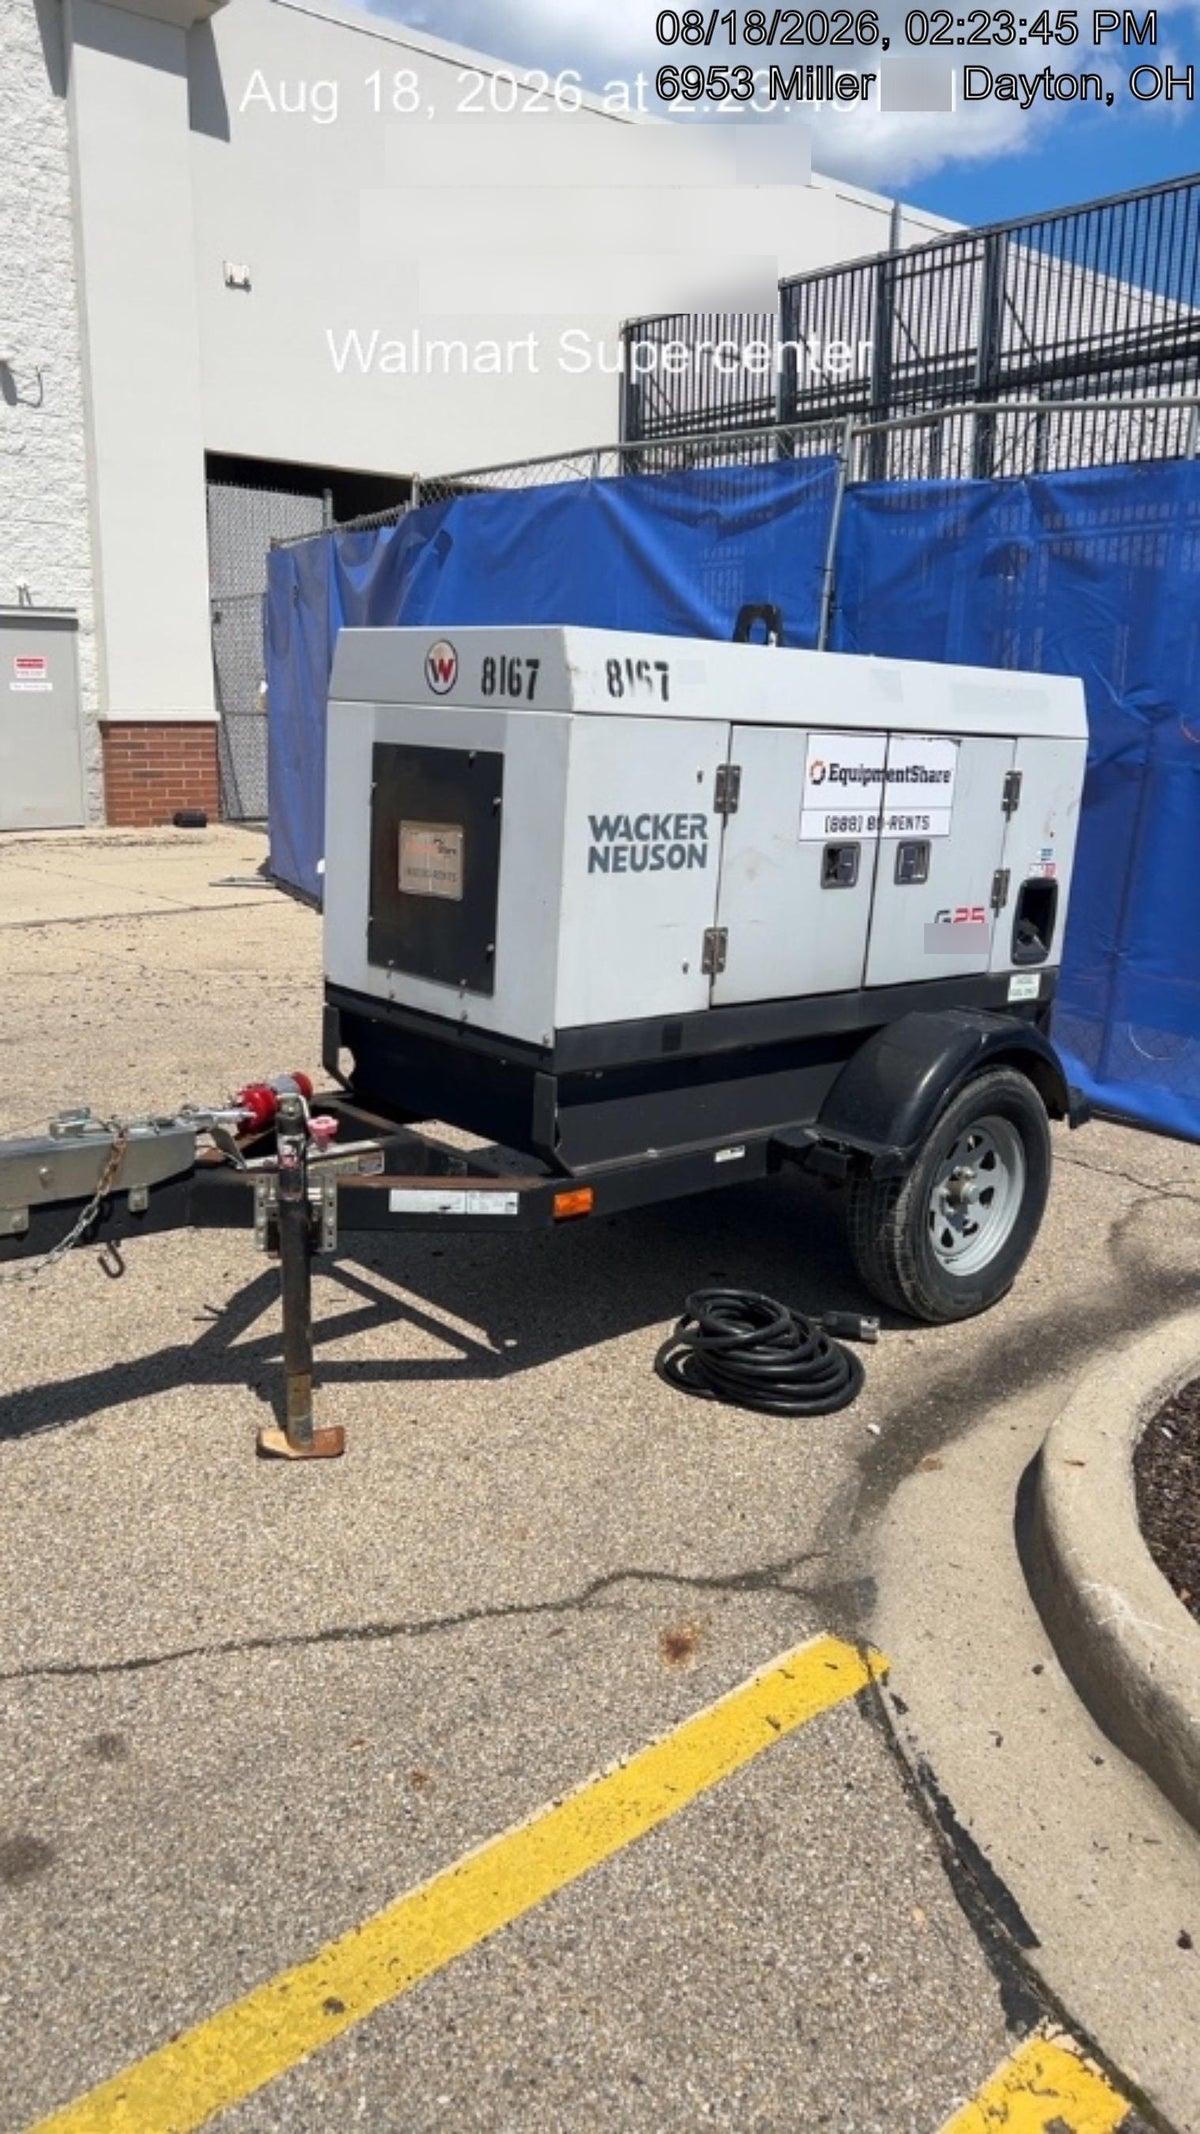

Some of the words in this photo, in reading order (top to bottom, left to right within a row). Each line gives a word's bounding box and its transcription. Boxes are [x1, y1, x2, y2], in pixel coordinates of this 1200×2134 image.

[481, 655, 541, 700] 8167
[829, 763, 952, 787] EquipmentShare
[588, 813, 709, 842] WACKER
[866, 814, 930, 832] 8-RENTS
[587, 843, 708, 874] NEUSON
